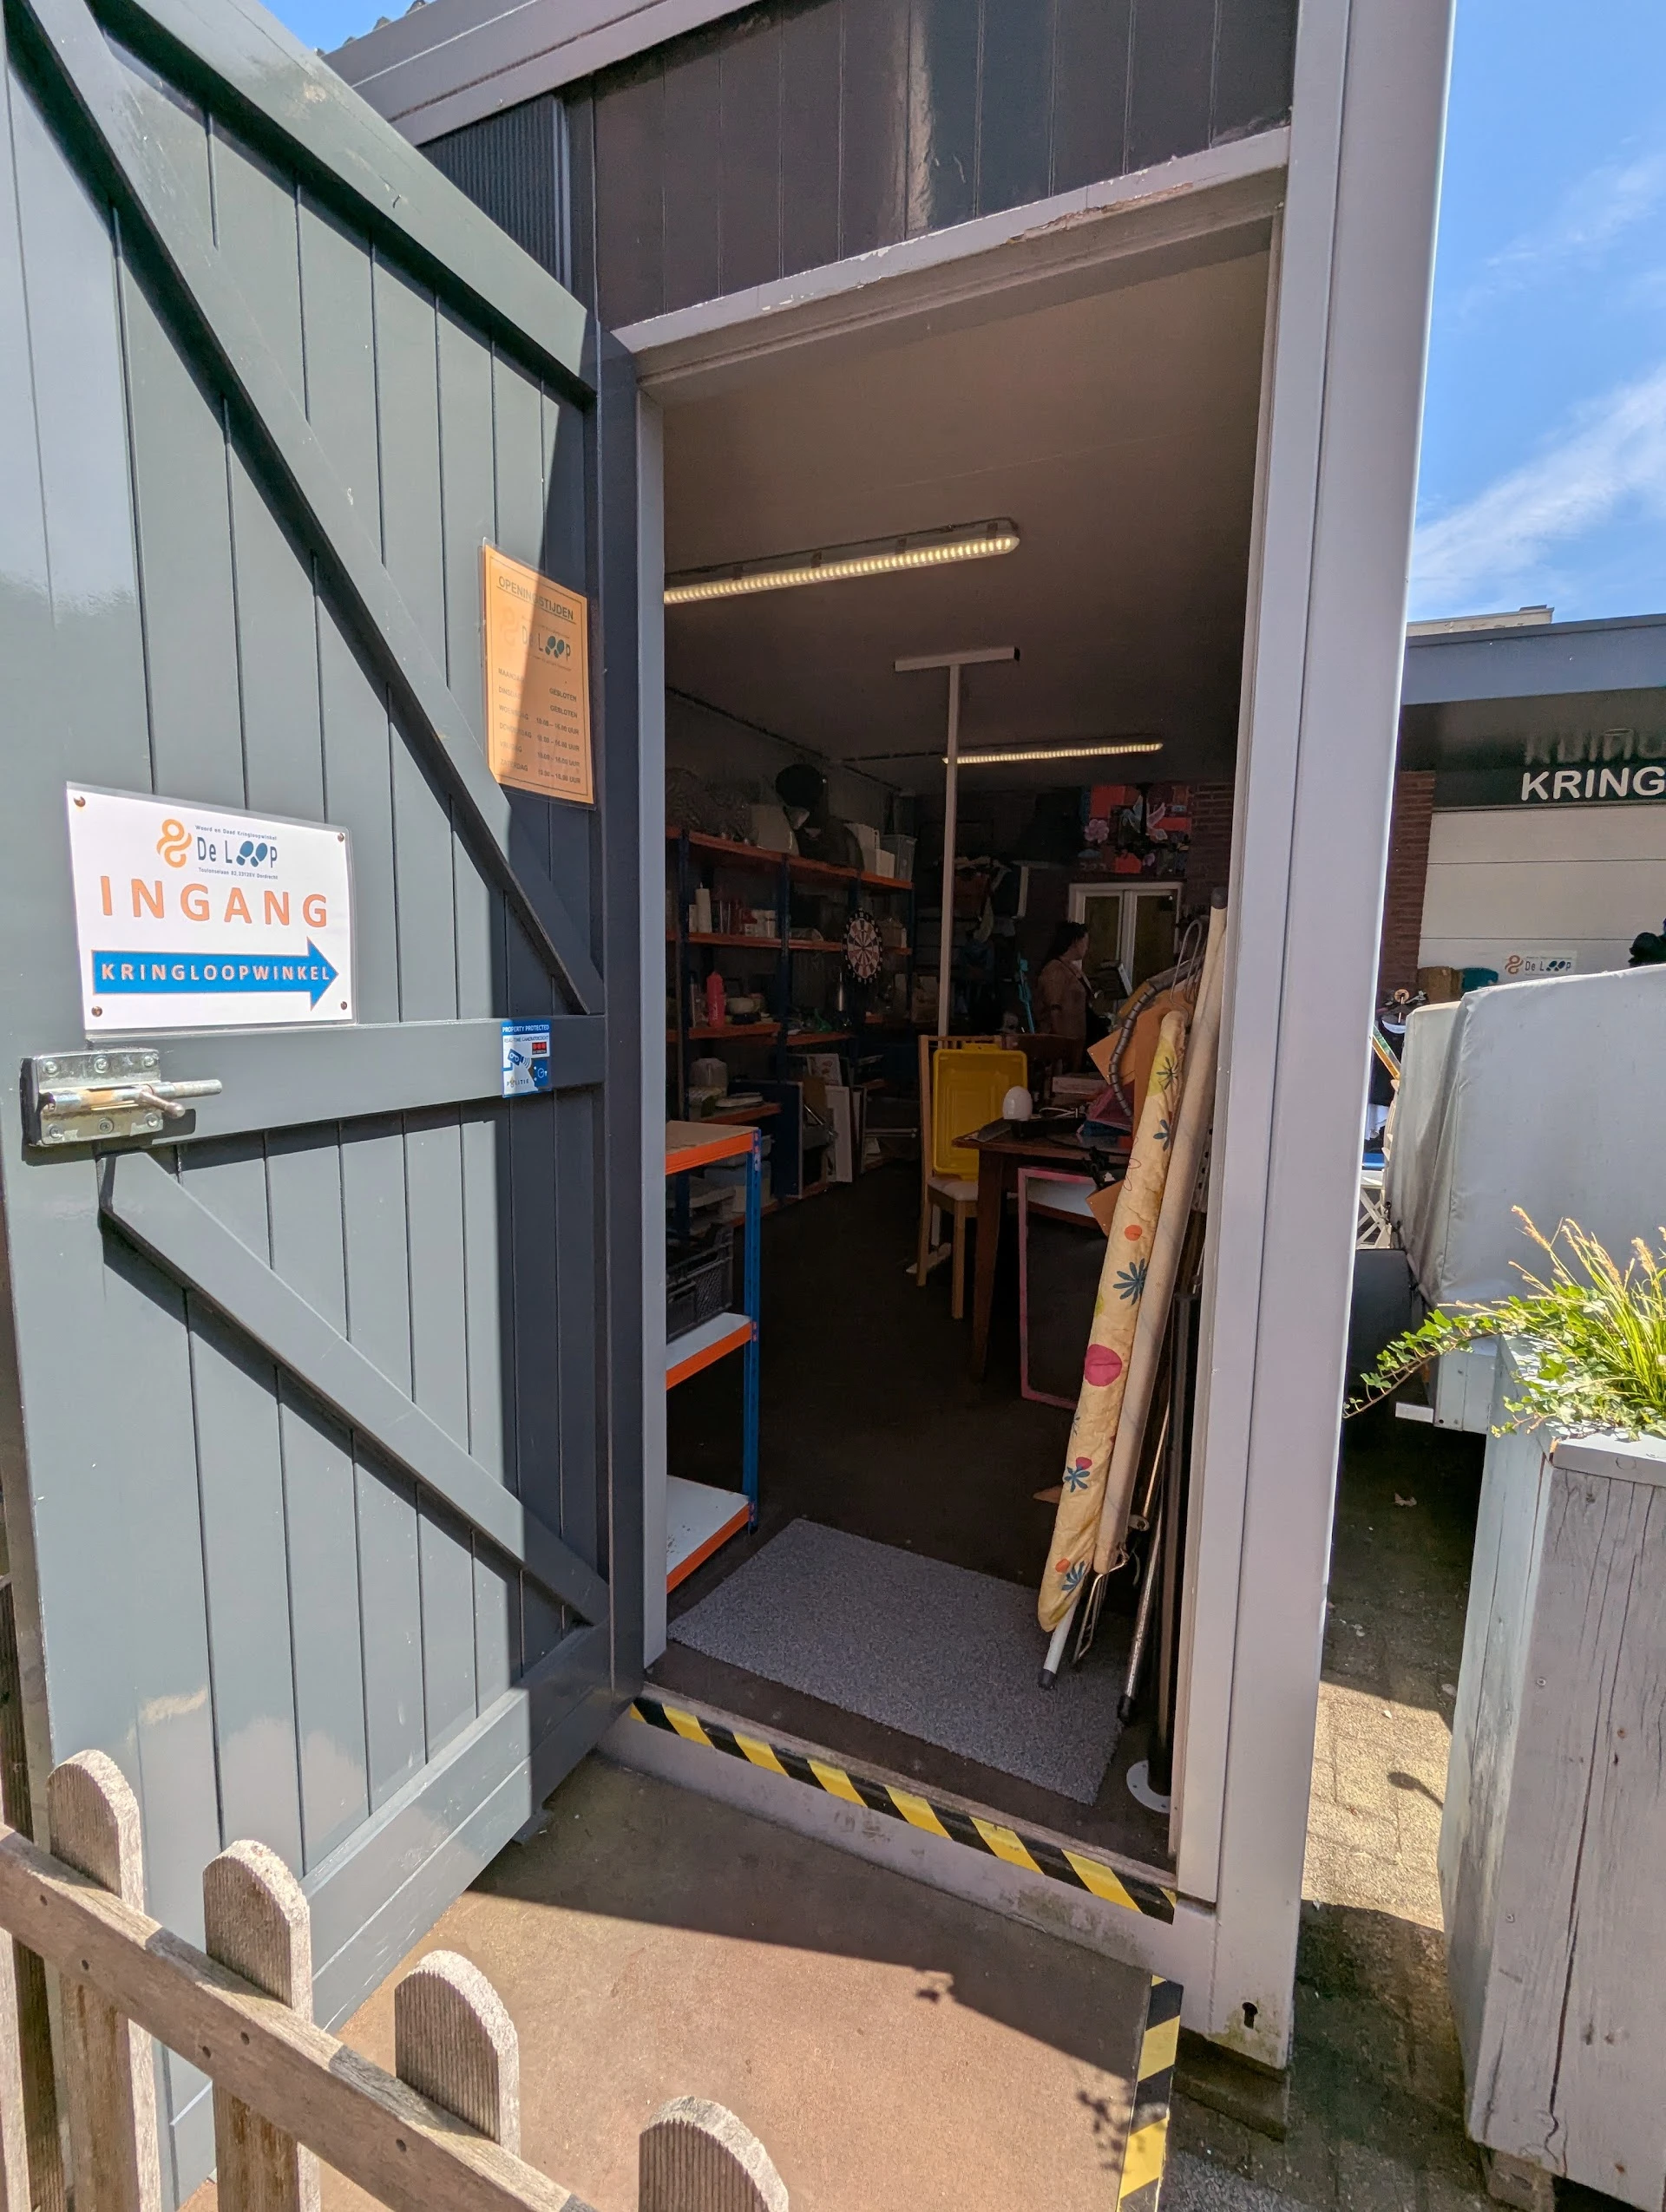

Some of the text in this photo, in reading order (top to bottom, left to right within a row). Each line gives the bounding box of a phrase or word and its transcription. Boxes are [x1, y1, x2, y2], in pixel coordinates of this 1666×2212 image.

[498, 576, 574, 620] OPENINGSTIJDEN
[549, 687, 577, 702] GESLOTEN
[550, 704, 578, 718] GESLOTEN
[567, 728, 580, 736] UUR
[1521, 766, 1665, 801] KRING
[237, 831, 277, 841] Kringloopwinkel
[197, 837, 216, 861] De
[100, 875, 327, 928] INGANG
[101, 963, 331, 981] KRINGLOOPWINKEL
[1525, 960, 1536, 971] De
